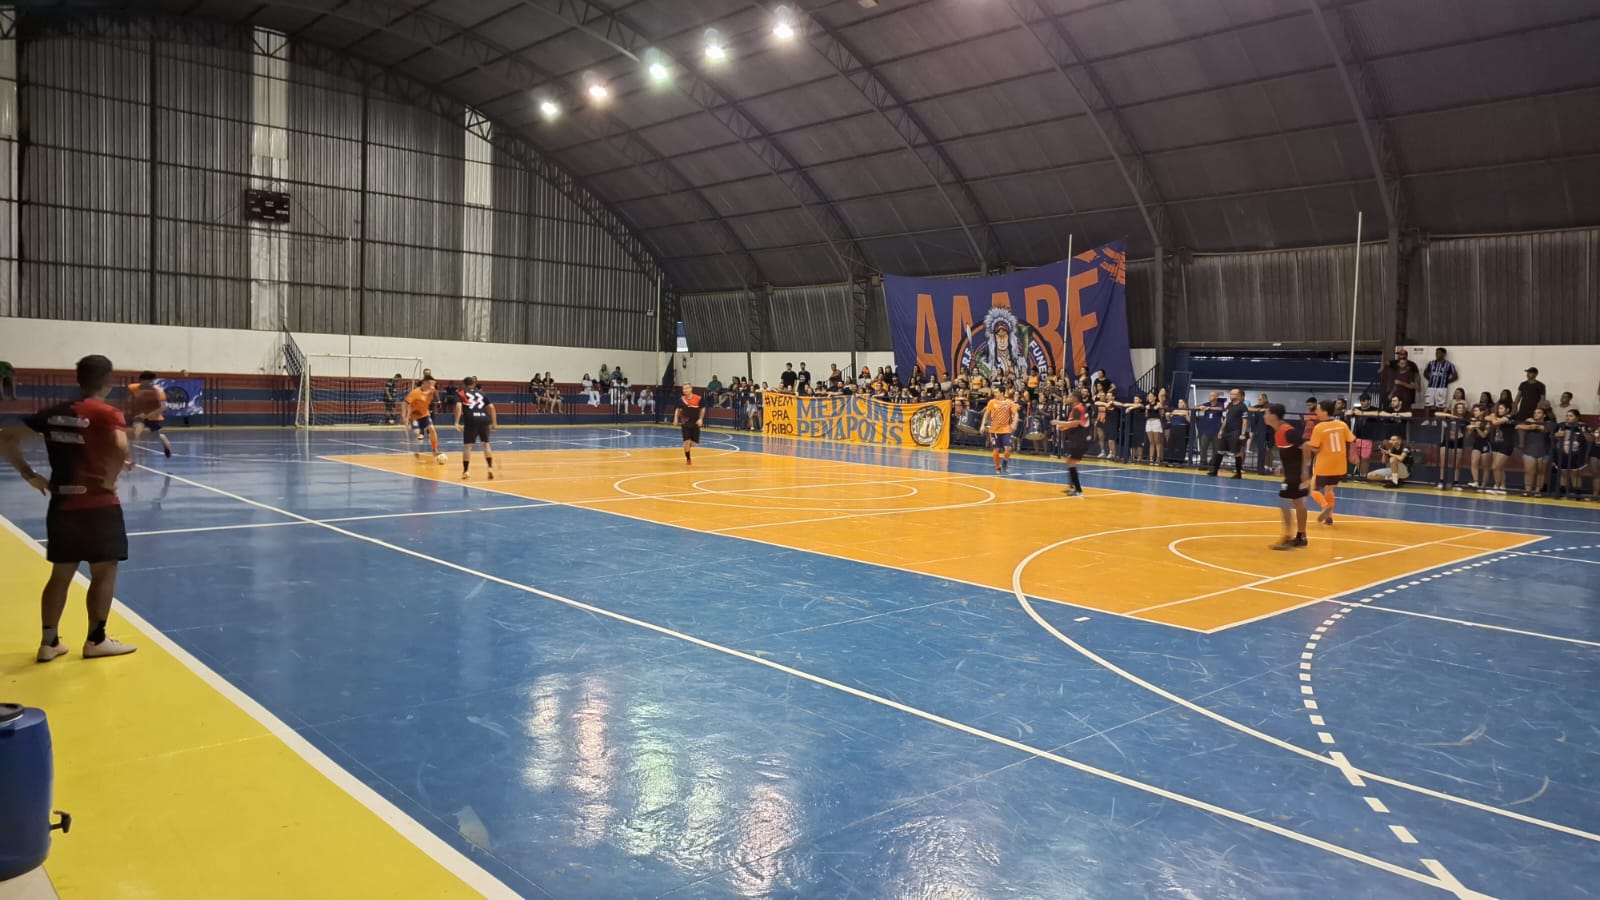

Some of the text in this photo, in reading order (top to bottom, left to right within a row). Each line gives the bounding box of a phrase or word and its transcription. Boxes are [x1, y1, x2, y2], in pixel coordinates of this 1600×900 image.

[466, 392, 485, 409] 33
[764, 394, 794, 409] #VEM
[771, 410, 790, 421] PRA
[796, 395, 906, 425] MEDICINA
[765, 421, 794, 435] TRIBO
[796, 416, 905, 446] PENAPOLIS
[1329, 431, 1341, 452] 11
